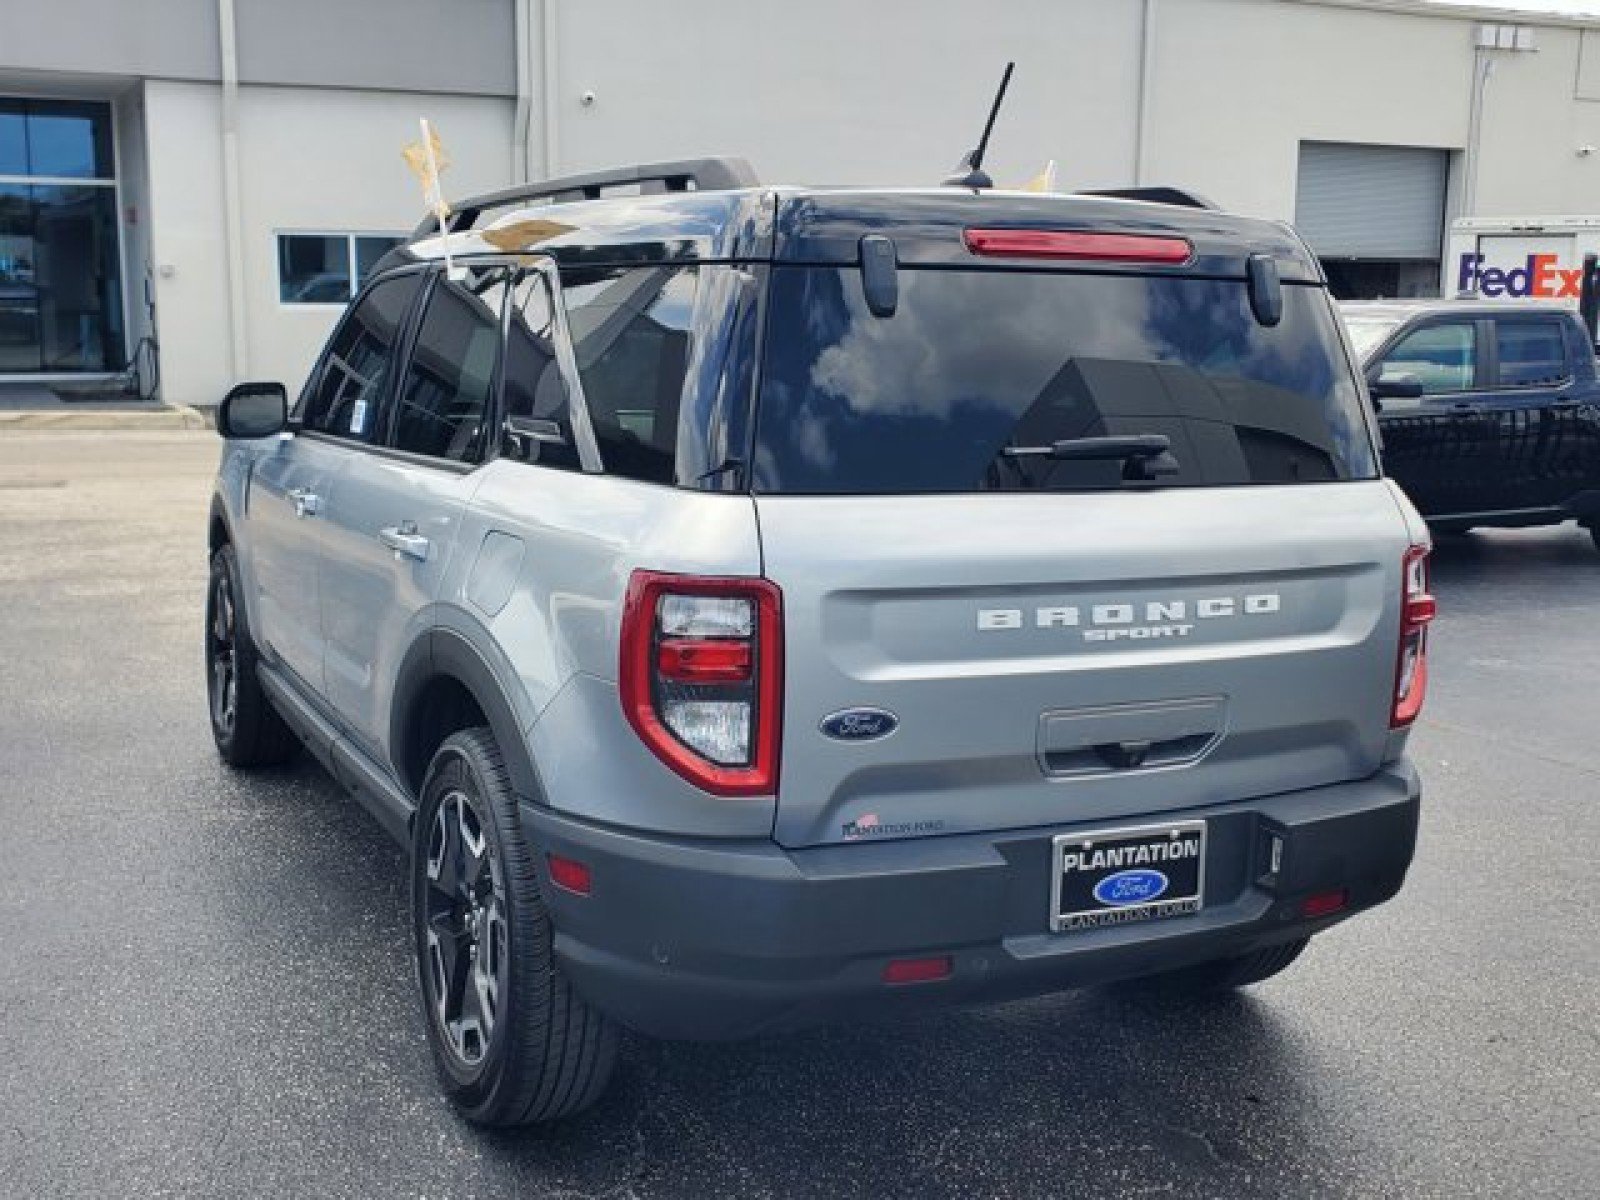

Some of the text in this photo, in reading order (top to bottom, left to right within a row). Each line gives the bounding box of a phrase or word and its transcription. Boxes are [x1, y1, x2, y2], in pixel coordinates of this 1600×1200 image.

[1458, 254, 1581, 297] FedEx
[977, 594, 1280, 630] BRONCO
[1082, 624, 1193, 641] SPORT
[1064, 839, 1198, 873] PLANTATION
[1111, 876, 1154, 898] Ford
